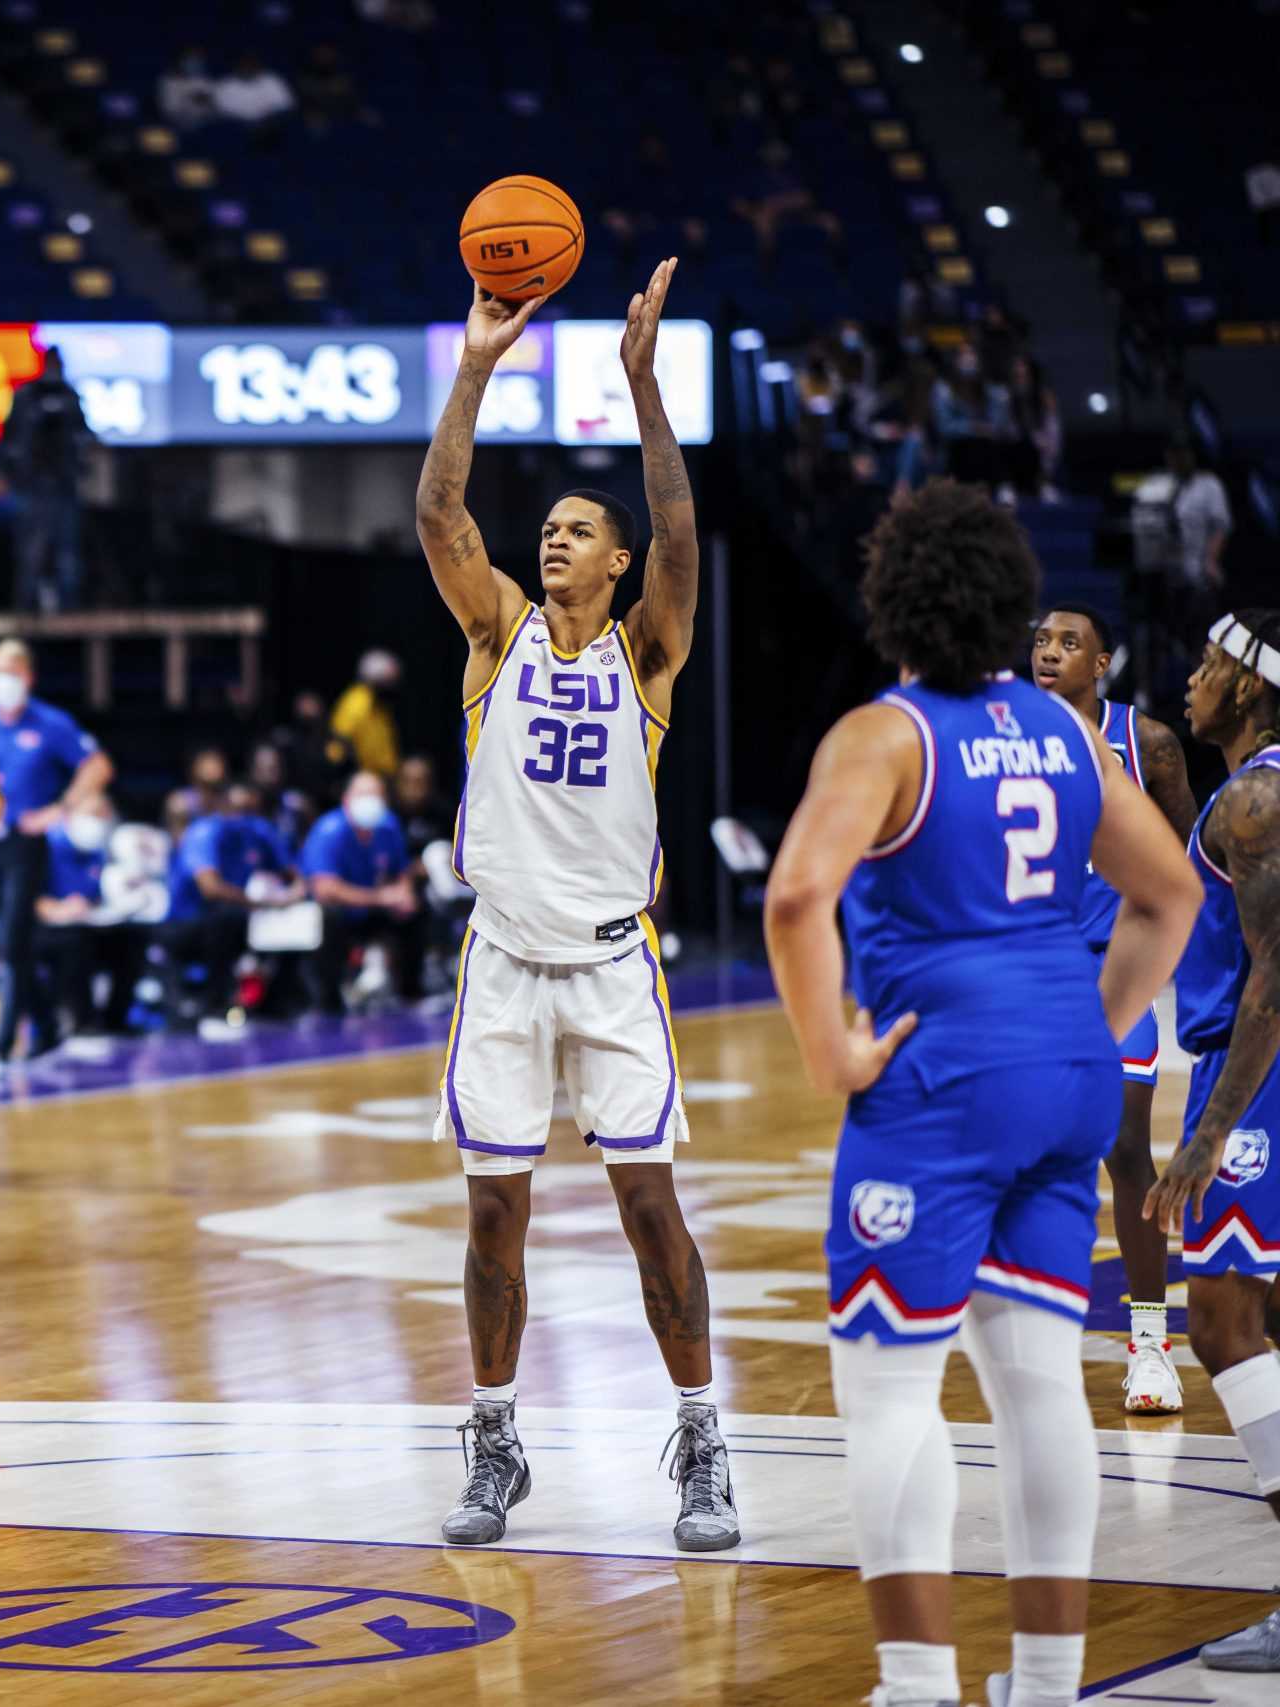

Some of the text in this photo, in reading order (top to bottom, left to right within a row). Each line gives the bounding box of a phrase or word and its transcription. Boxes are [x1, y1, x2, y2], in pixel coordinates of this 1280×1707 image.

[481, 238, 530, 261] LSU
[201, 343, 401, 424] 13:43
[517, 663, 620, 712] LSU
[523, 717, 608, 787] 32
[959, 735, 1077, 779] LOFTON JR.
[996, 777, 1059, 904] 2
